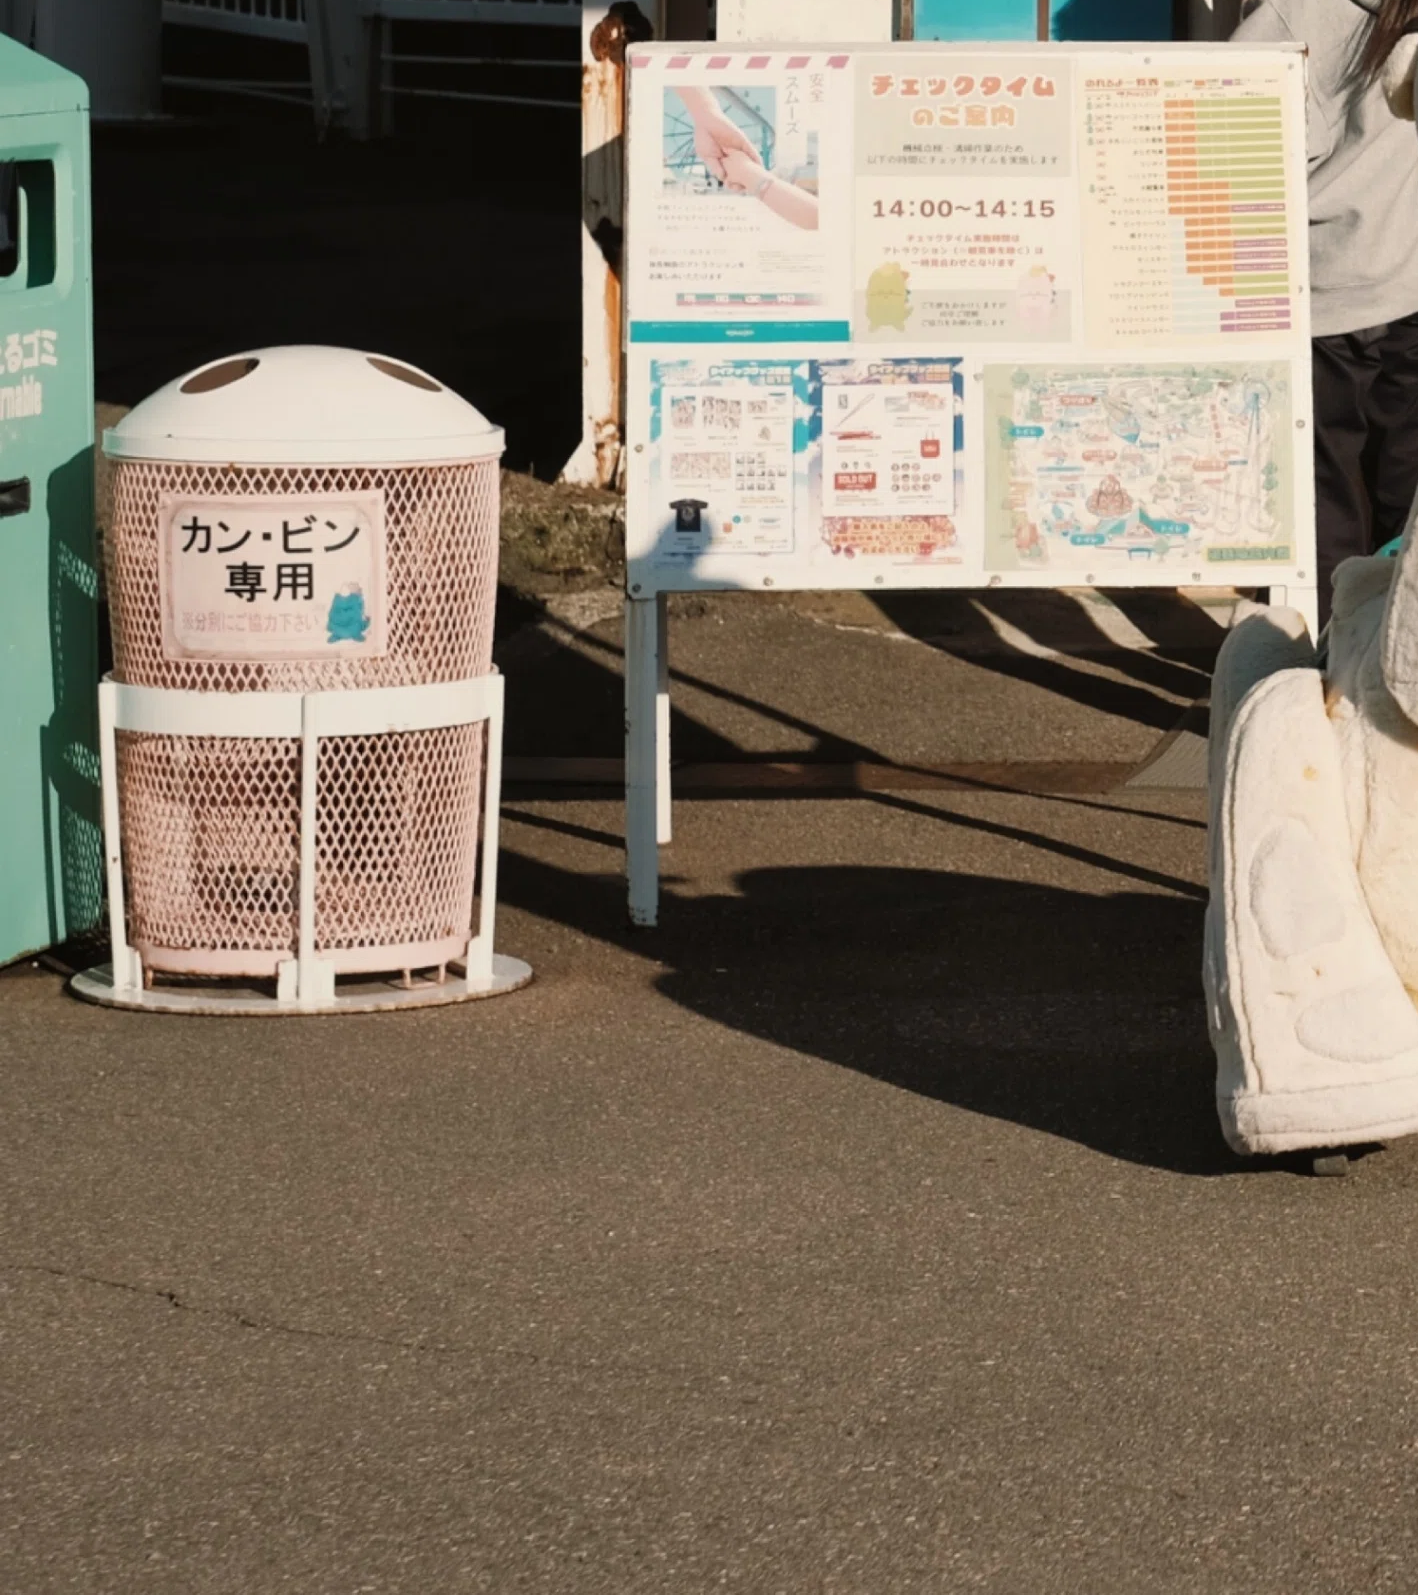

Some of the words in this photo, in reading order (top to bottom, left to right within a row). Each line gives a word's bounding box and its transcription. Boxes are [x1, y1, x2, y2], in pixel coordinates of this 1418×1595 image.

[871, 74, 1056, 97] チェックタイム
[912, 104, 1016, 127] のご案内
[181, 514, 361, 554] カン・ビン
[224, 561, 314, 603] 専用
